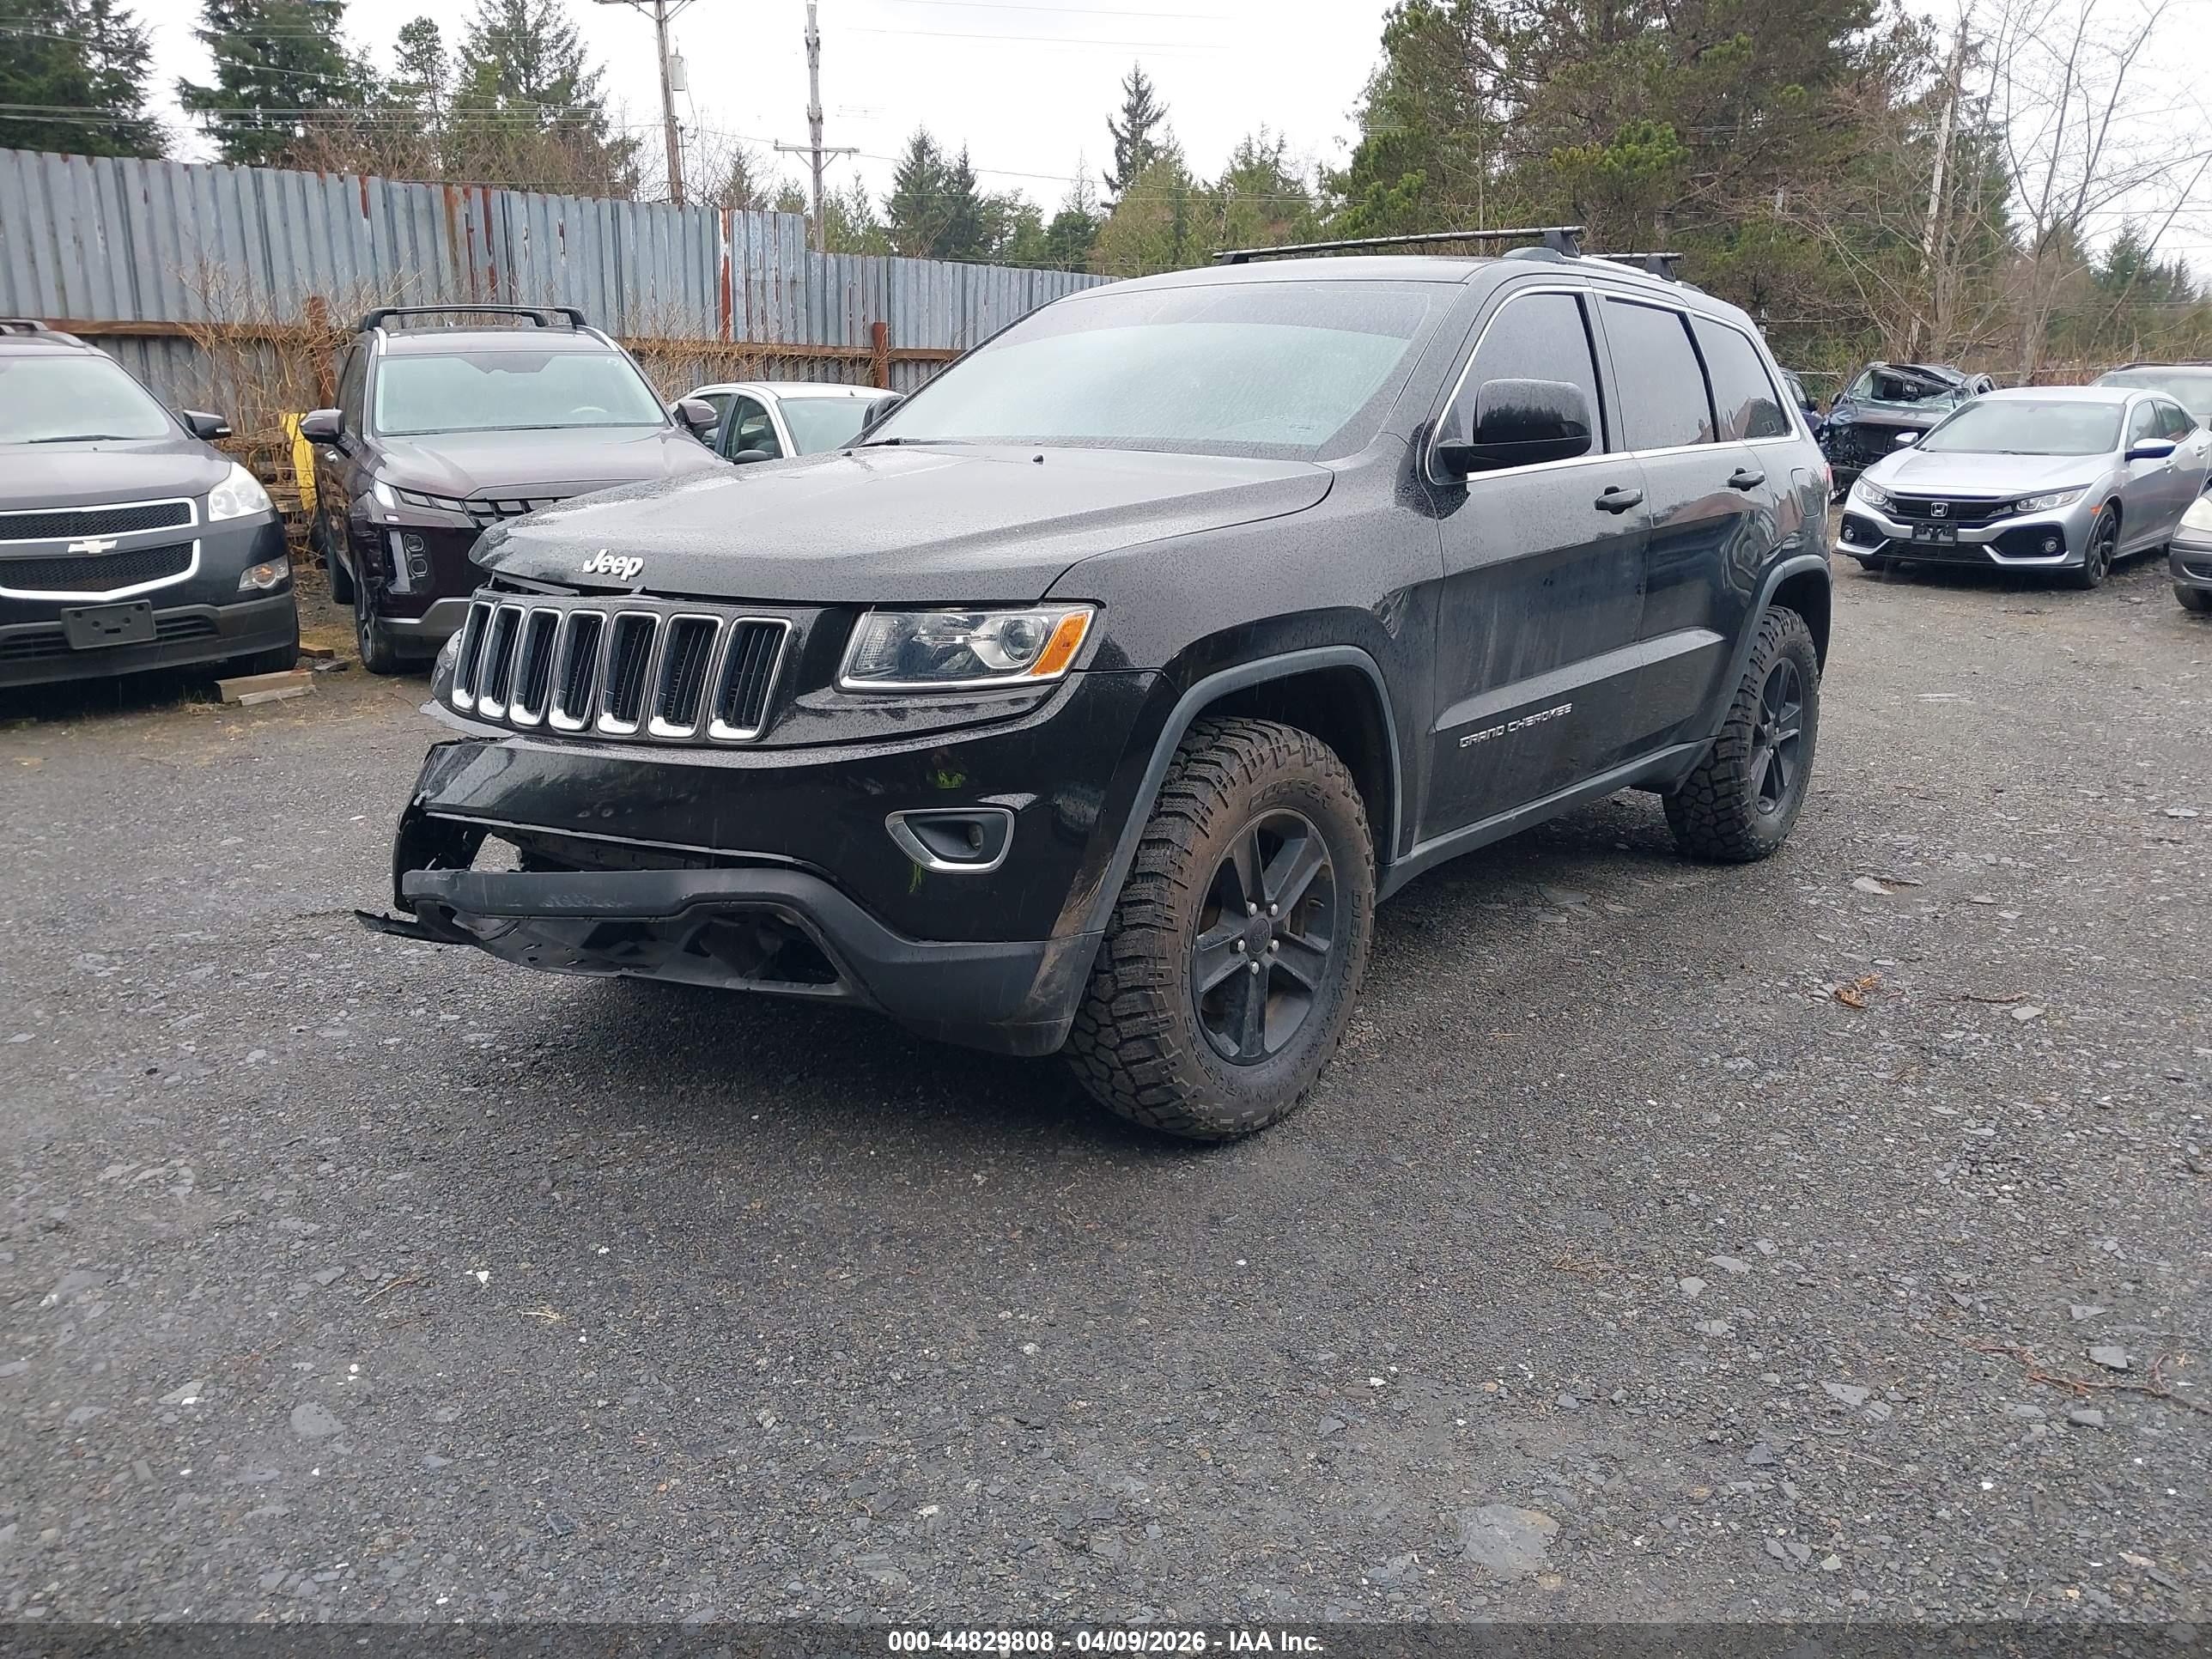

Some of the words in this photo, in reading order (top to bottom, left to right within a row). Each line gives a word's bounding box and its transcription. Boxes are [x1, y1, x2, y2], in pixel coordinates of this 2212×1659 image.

[582, 549, 645, 582] Jeep
[1459, 725, 1504, 749] GRAND
[1507, 702, 1572, 732] CHEROKEE
